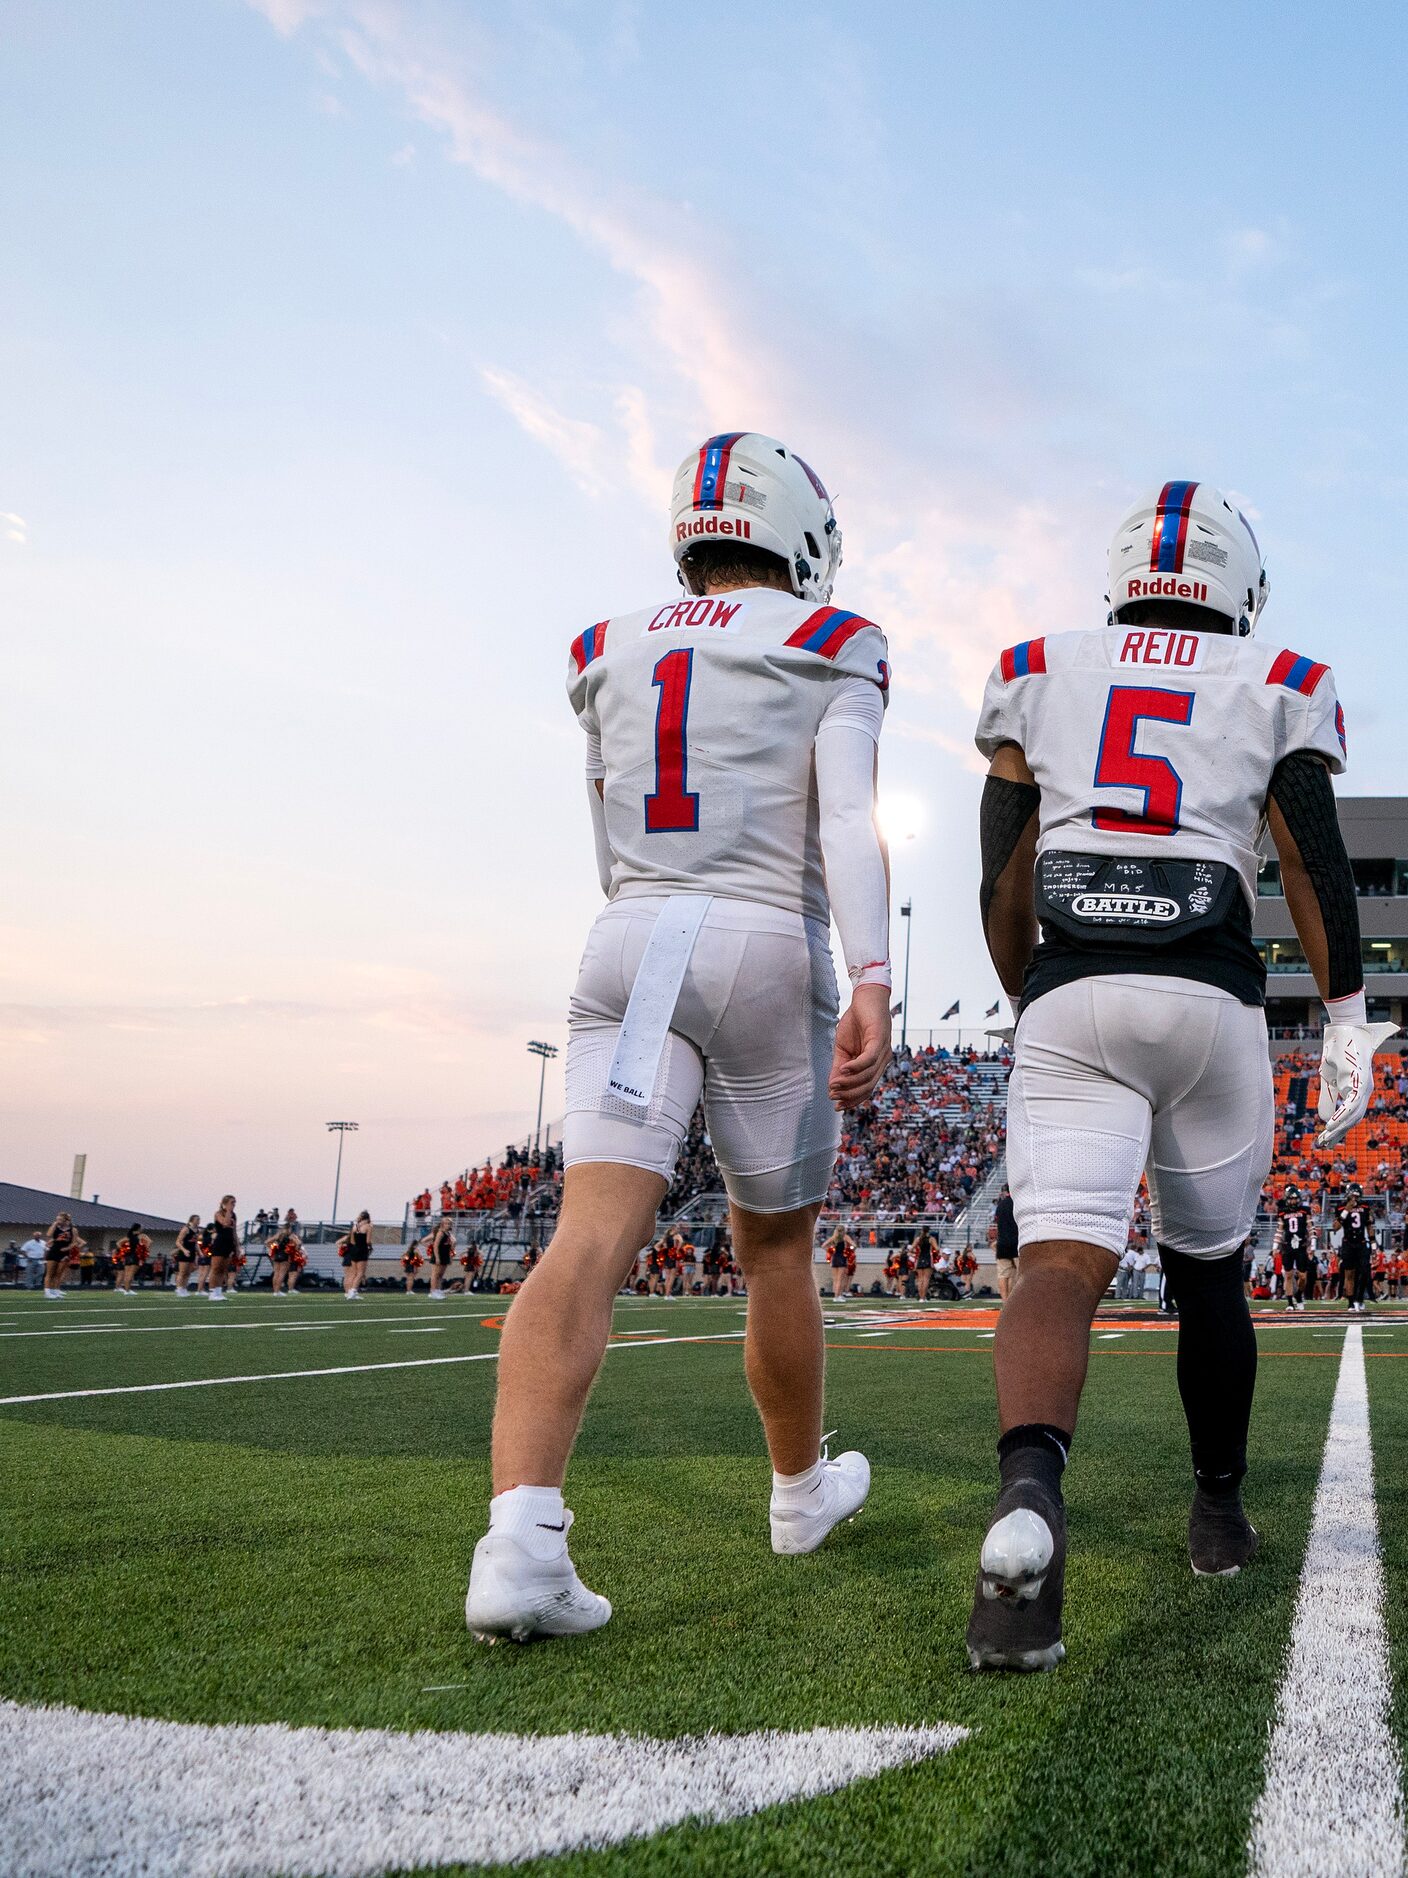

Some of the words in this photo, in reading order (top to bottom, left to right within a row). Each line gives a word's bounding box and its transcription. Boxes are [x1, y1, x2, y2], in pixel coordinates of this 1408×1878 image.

[676, 516, 751, 541] Riddell
[1127, 578, 1208, 602] Riddell
[647, 599, 743, 632] CROW
[1120, 631, 1200, 667] REID
[644, 647, 700, 834] 1
[1091, 684, 1196, 836] 5
[1081, 897, 1170, 917] BATTLE
[610, 1079, 623, 1091] WE
[623, 1086, 645, 1099] BALL.
[1288, 1217, 1299, 1233] 0
[1350, 1212, 1361, 1228] 3
